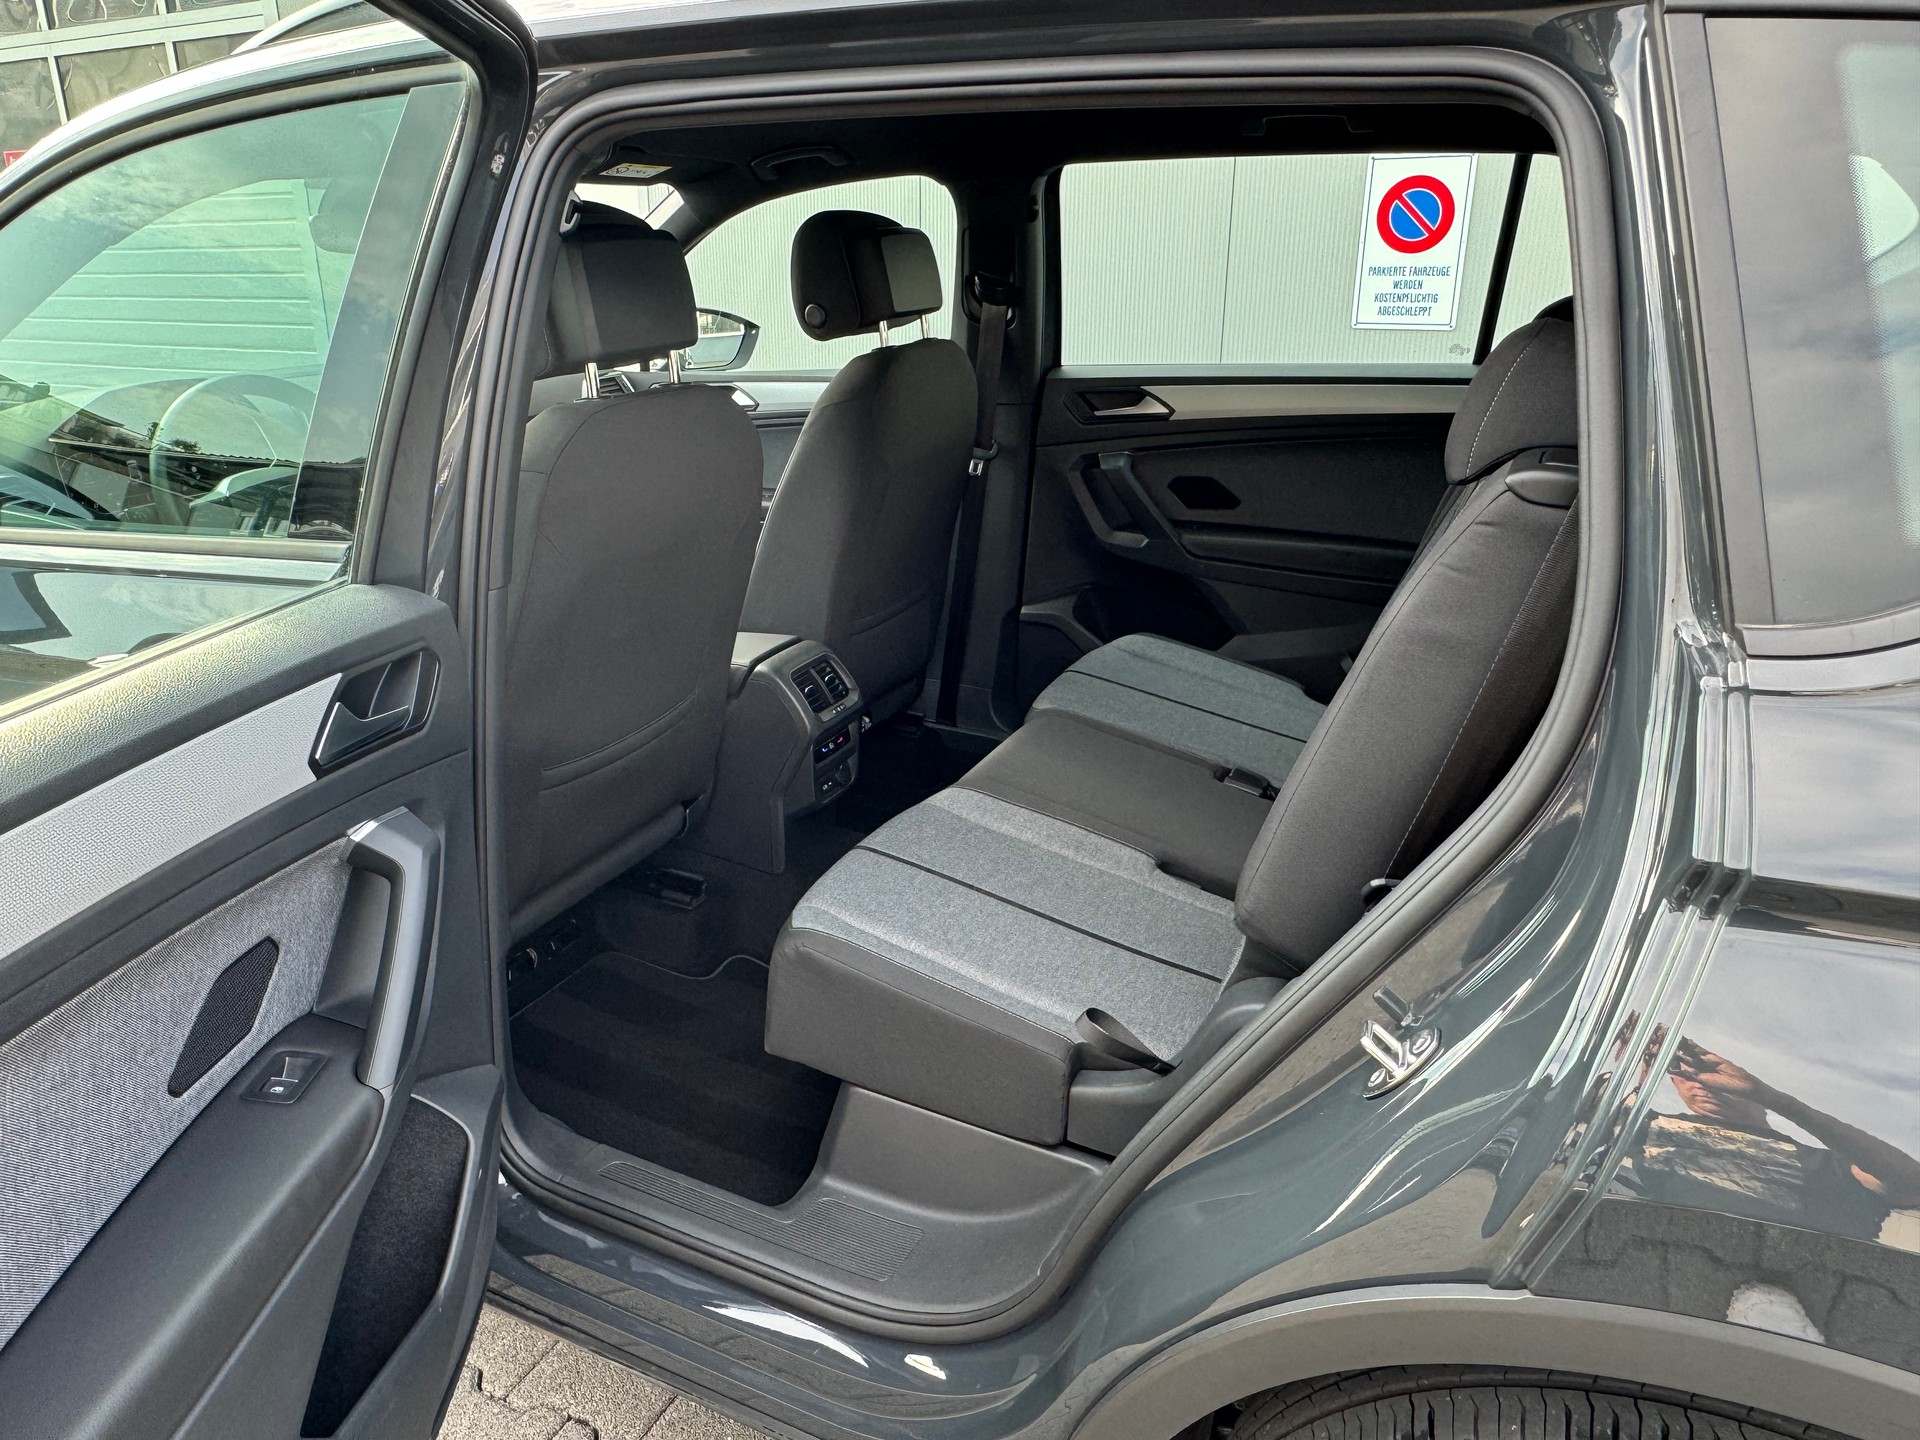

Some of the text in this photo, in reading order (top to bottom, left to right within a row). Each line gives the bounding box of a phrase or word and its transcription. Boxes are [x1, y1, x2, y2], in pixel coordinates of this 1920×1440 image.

[1368, 266, 1451, 276] PARKIERTE FAHRZEUGE
[1393, 280, 1423, 289] WERDEN
[1374, 293, 1438, 303] KOSTENPFLICHTIG
[1377, 306, 1432, 316] ABGESCHLEPPT
